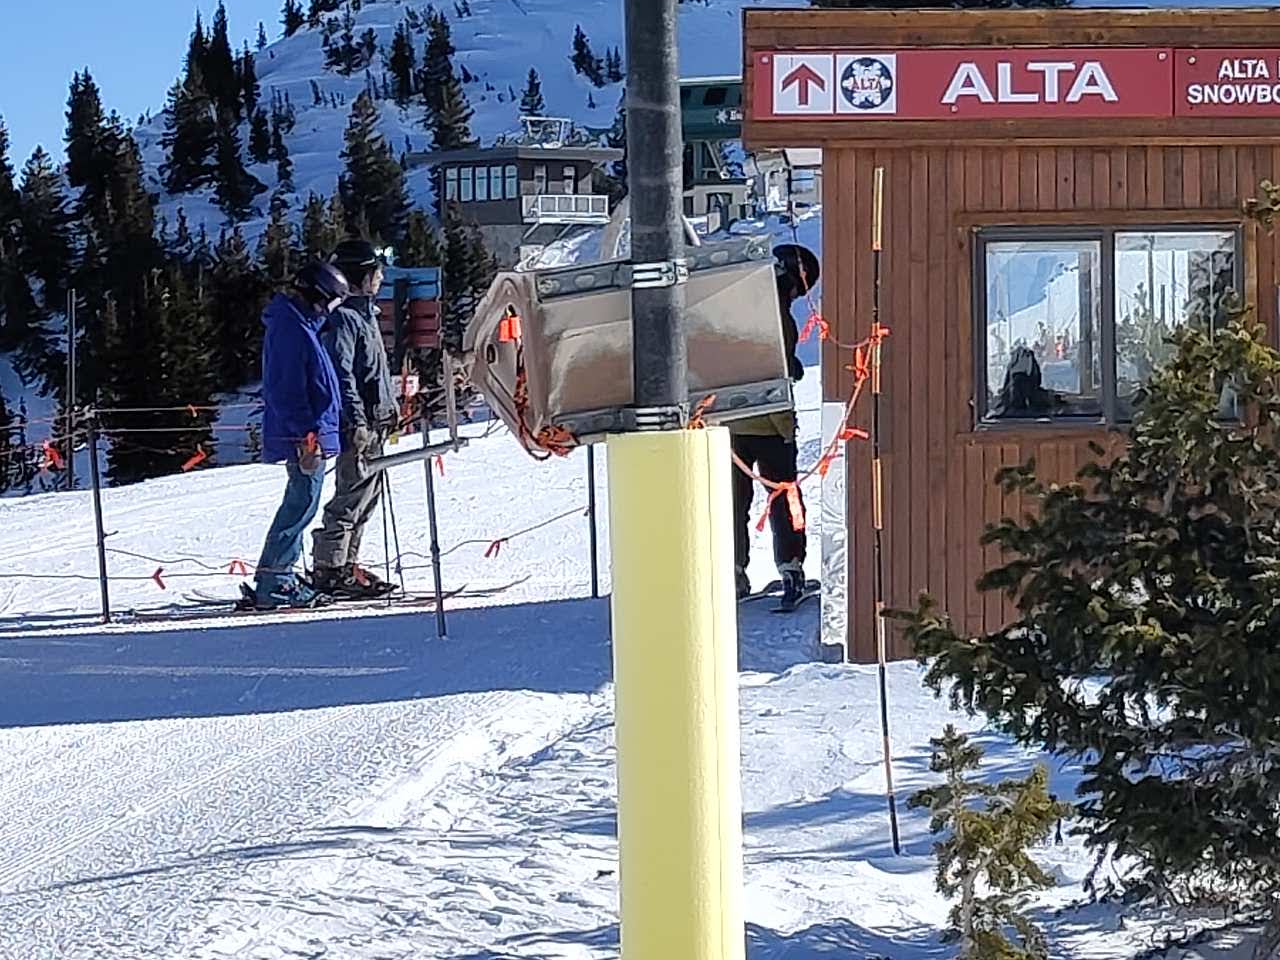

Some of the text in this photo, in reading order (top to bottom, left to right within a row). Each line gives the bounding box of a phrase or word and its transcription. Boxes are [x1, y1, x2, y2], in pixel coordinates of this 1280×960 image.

[1218, 58, 1270, 79] ALTA
[851, 74, 883, 91] ALTA
[940, 61, 1119, 104] ALTA
